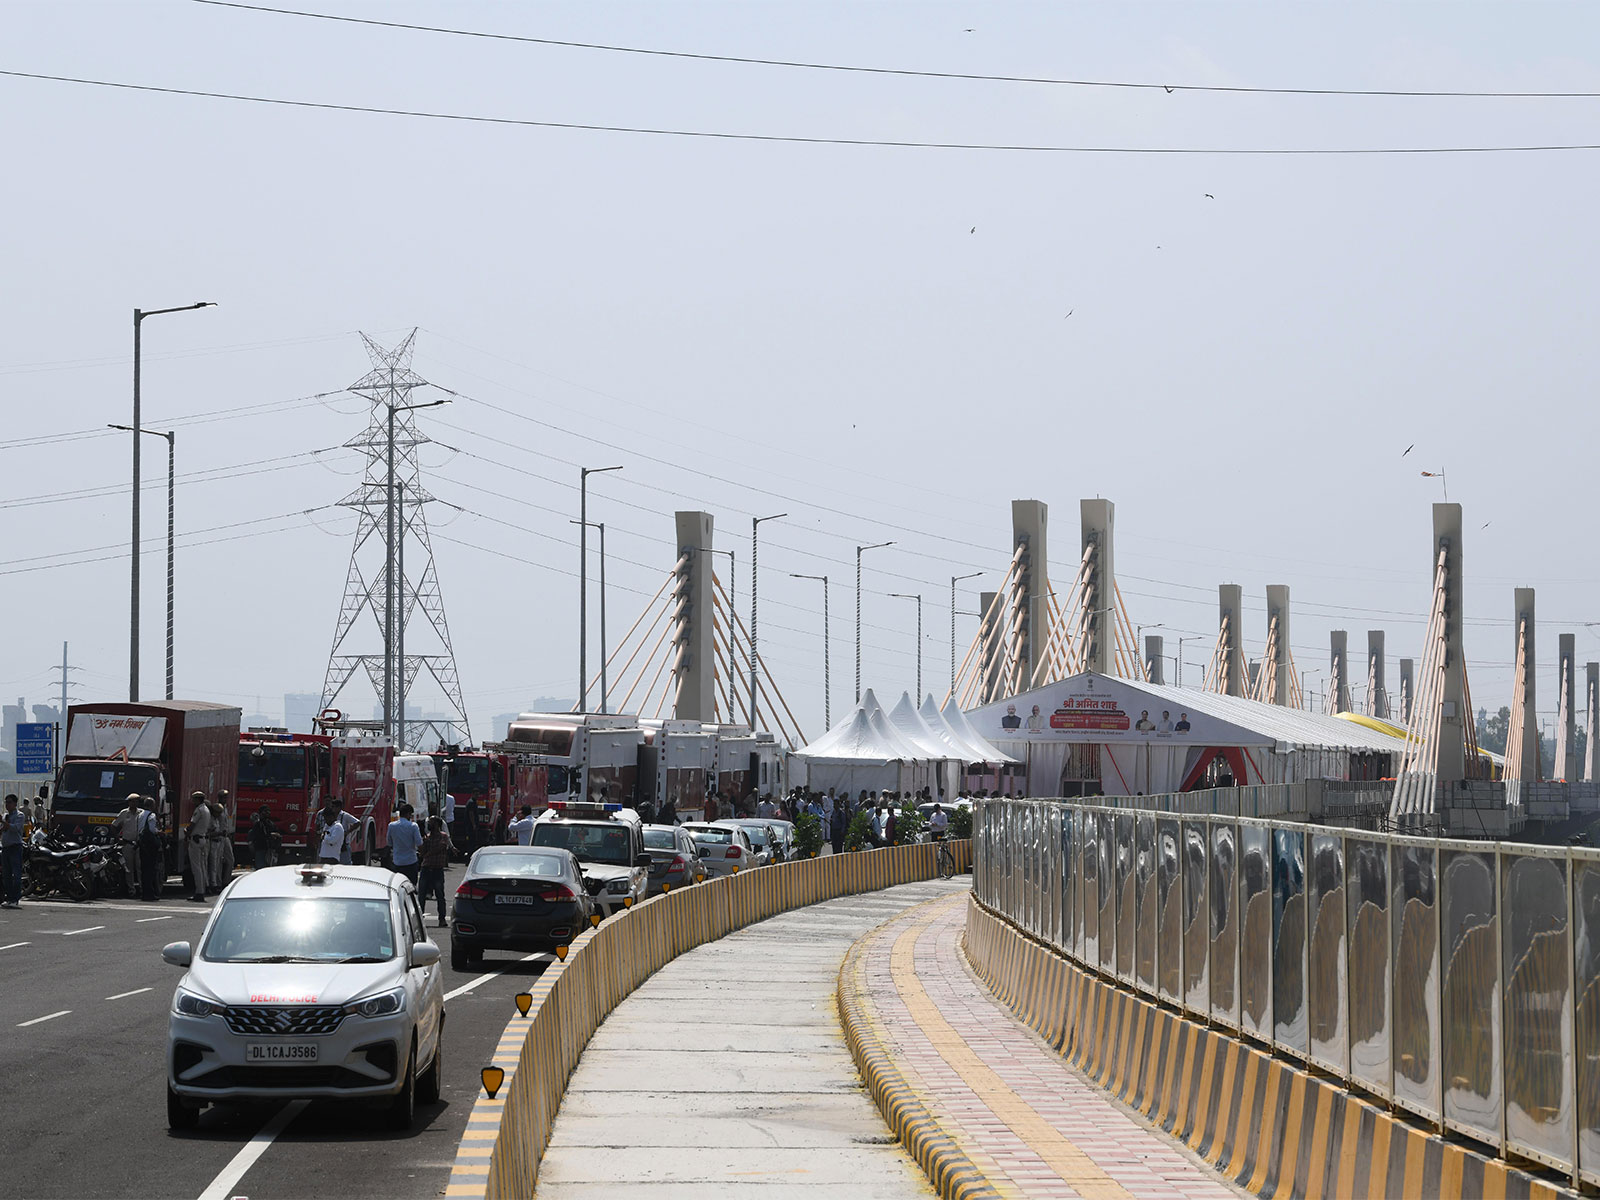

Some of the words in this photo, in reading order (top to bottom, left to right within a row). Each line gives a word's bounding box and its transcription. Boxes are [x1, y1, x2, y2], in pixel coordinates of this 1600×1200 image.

[1063, 697, 1074, 708] श्री
[1076, 698, 1099, 709] अमित
[1100, 701, 1118, 710] शाह
[285, 803, 300, 811] FIRE
[250, 994, 279, 1003] DELHI
[252, 1046, 316, 1059] DL1CAJ3586
